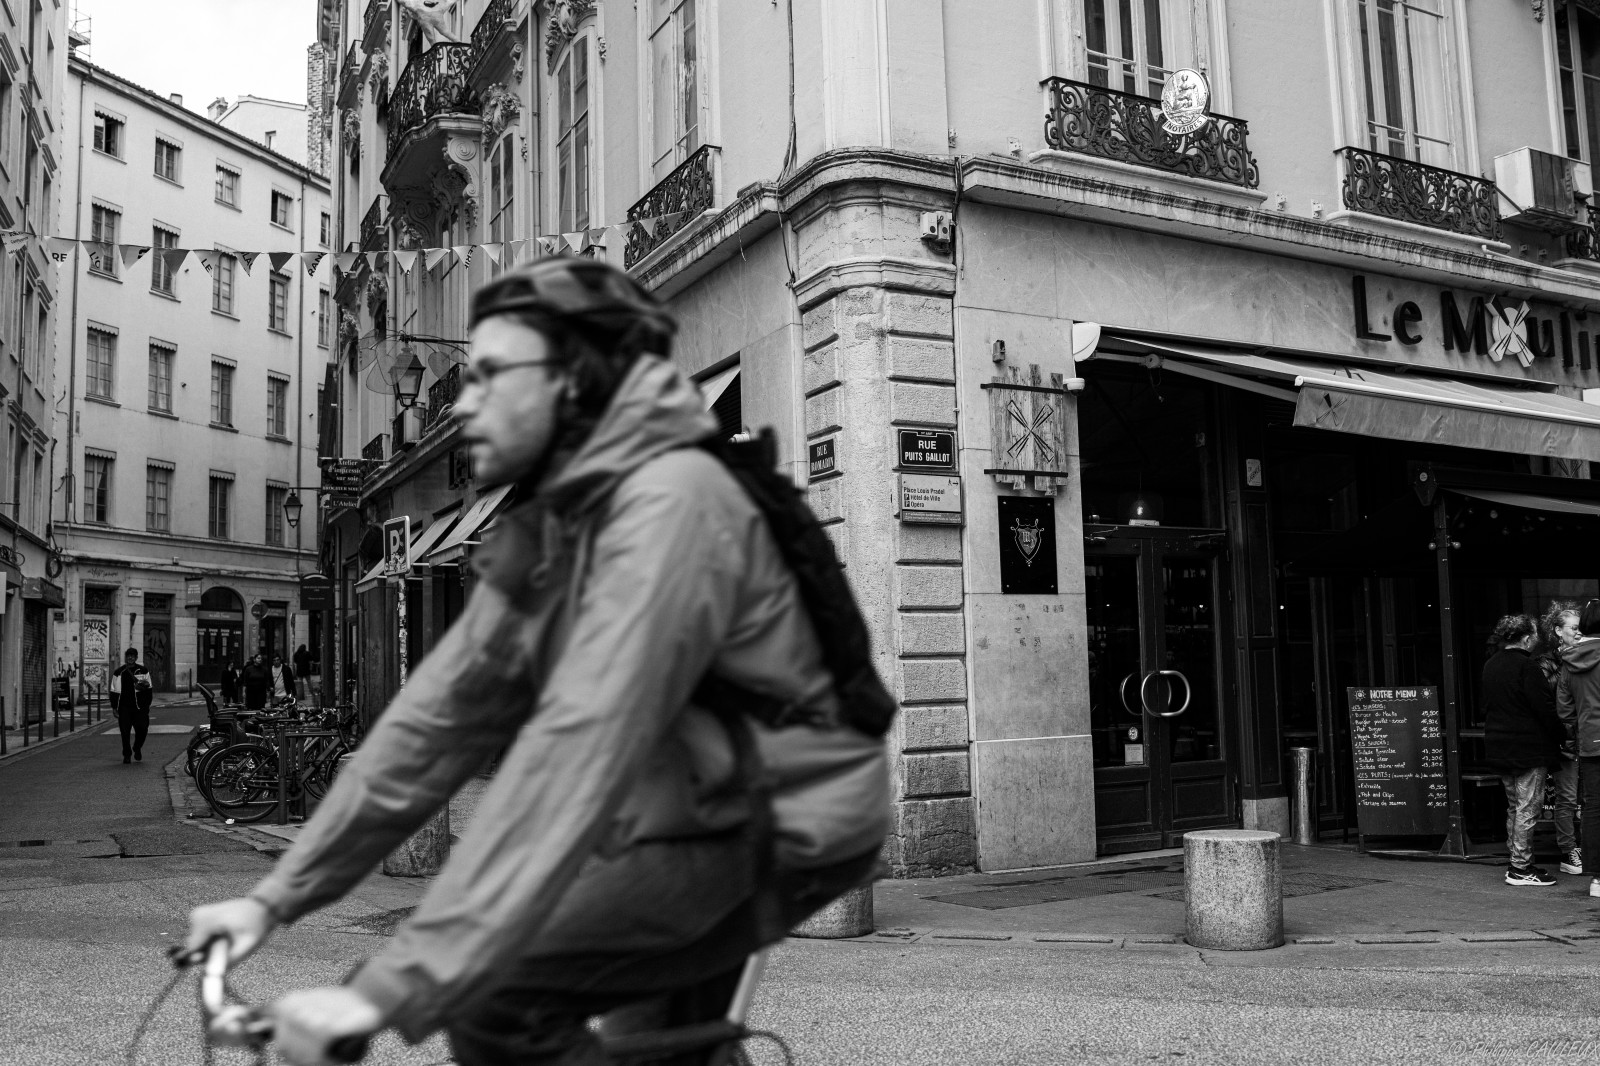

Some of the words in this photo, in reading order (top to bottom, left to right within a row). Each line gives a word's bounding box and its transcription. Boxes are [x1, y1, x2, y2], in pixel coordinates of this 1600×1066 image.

[1167, 120, 1203, 133] NOTAIRES
[1352, 275, 1423, 345] Le
[1440, 289, 1600, 371] Mouli
[816, 444, 828, 457] RUE
[918, 440, 937, 450] RUE
[904, 451, 923, 461] PUITS
[925, 452, 950, 462] GAILLOT
[1370, 690, 1393, 699] NOTRE
[1395, 690, 1417, 699] MENU
